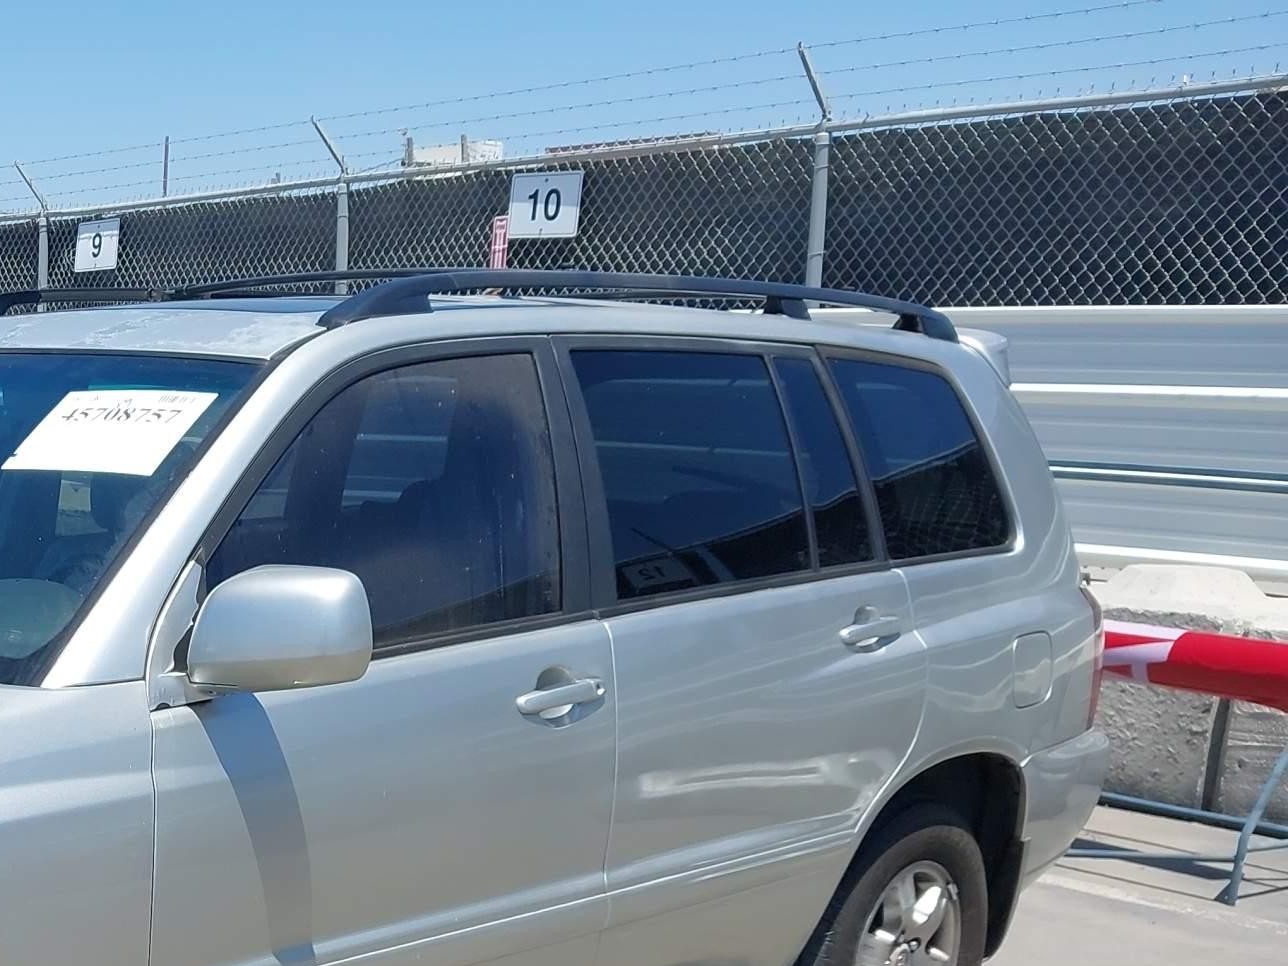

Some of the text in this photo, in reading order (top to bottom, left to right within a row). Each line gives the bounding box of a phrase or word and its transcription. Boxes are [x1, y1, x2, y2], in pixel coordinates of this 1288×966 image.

[528, 188, 561, 221] 10
[92, 233, 102, 258] 9
[61, 408, 183, 424] 45708757
